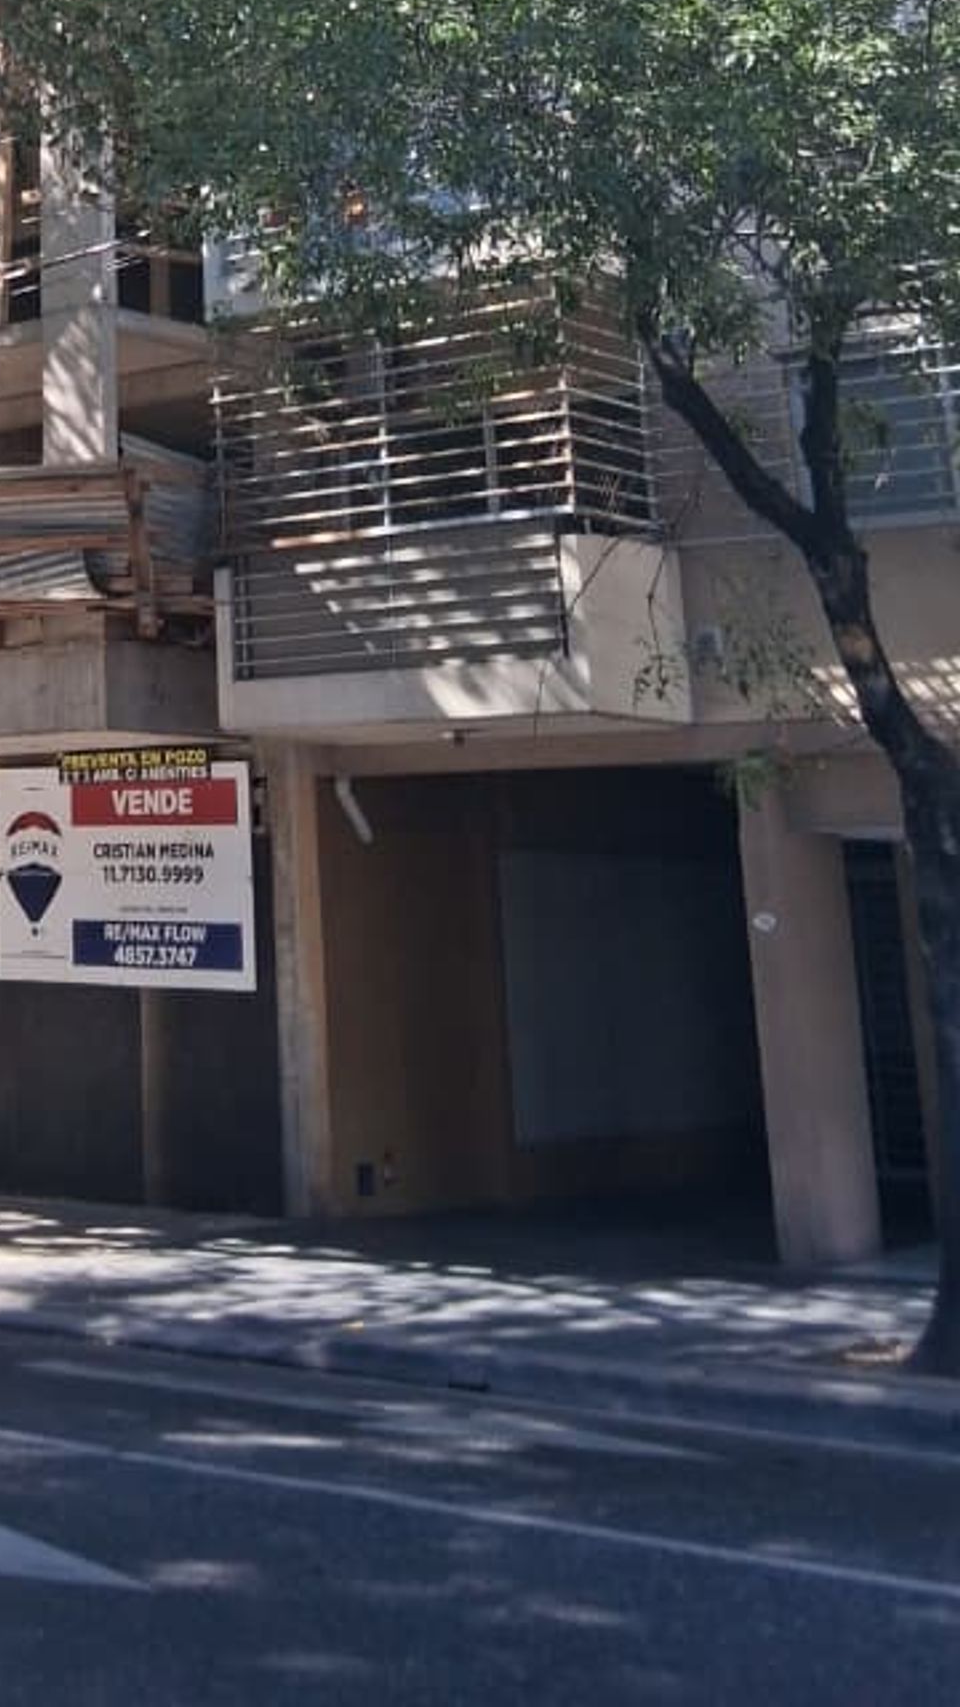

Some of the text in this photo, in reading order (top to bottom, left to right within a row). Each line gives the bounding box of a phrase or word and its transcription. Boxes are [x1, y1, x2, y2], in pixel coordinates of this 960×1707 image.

[165, 748, 207, 767] POZO
[111, 788, 194, 816] VENDE
[93, 843, 215, 859] CRISTIAN MEDINA
[104, 923, 207, 943] RE/MAX FLOW
